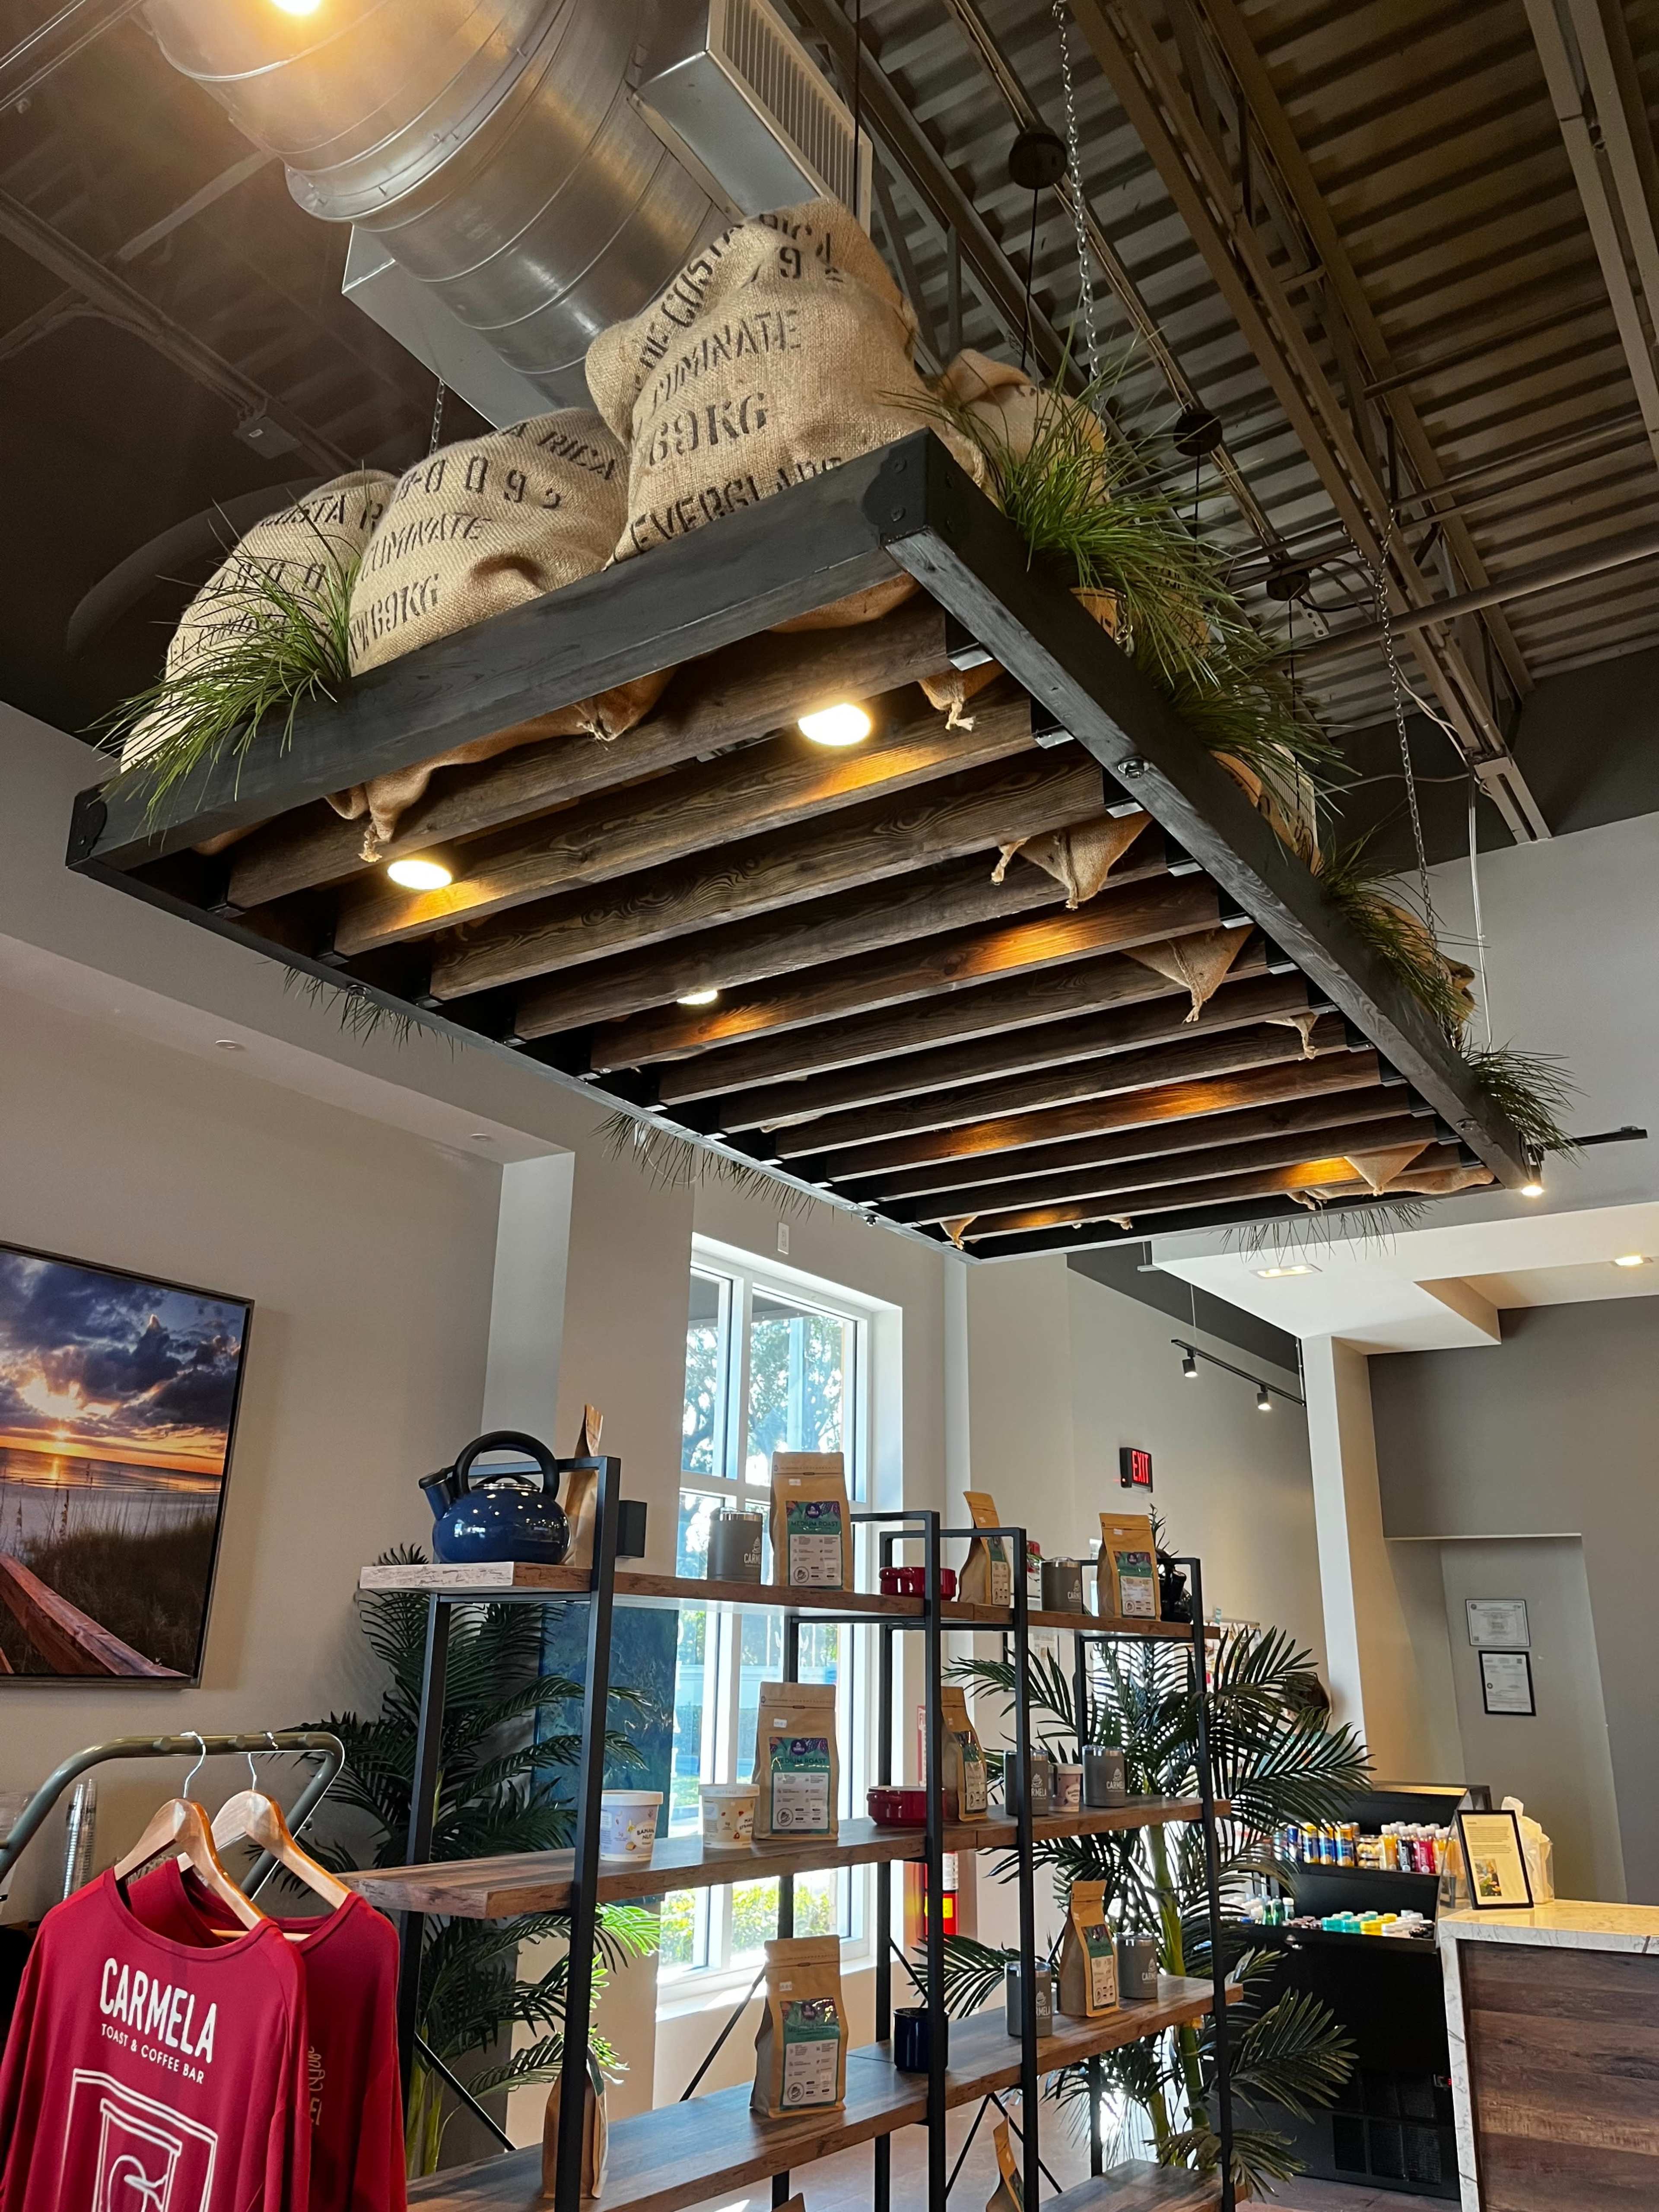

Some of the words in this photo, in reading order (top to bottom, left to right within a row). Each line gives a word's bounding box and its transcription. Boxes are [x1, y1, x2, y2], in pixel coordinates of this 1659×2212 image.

[537, 431, 615, 480] RICA
[650, 392, 768, 466] 69KG
[1132, 1450, 1149, 1484] EXIT
[100, 1958, 216, 2063] CARMELA
[102, 2023, 129, 2047] TOAST
[130, 2039, 137, 2052] &
[141, 2044, 180, 2072] COFFEE
[182, 2063, 204, 2084] BAR
